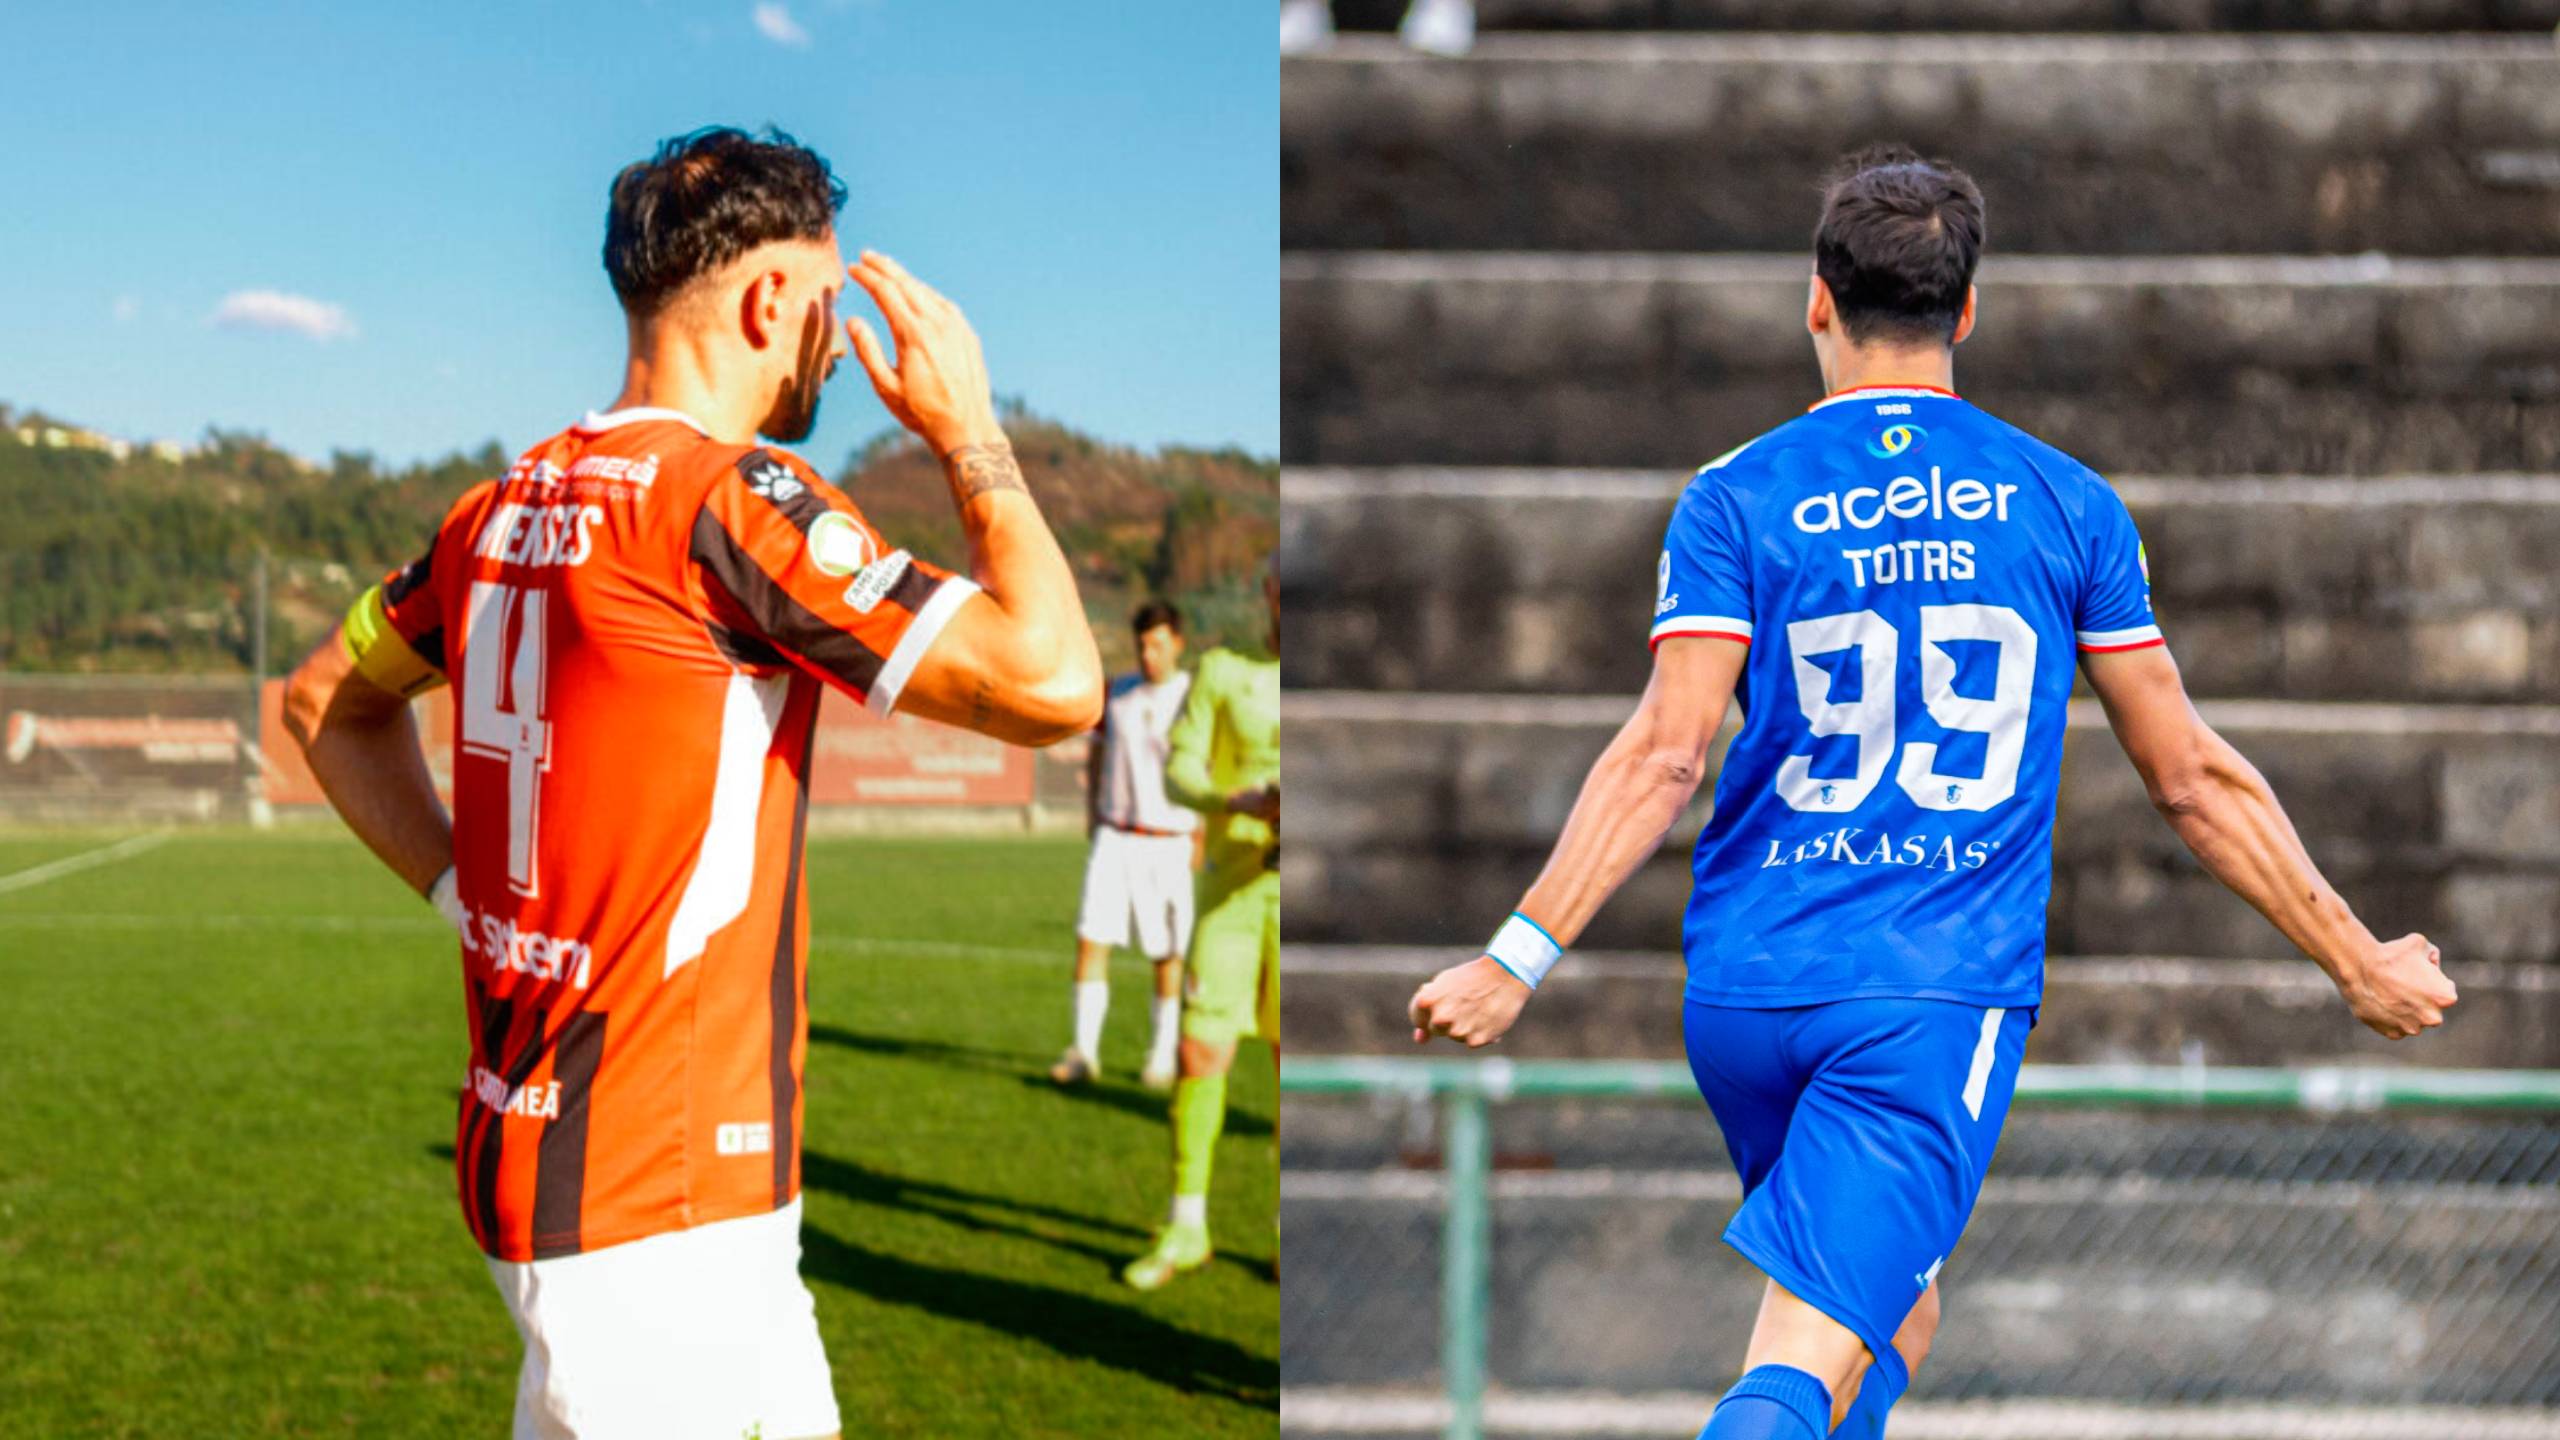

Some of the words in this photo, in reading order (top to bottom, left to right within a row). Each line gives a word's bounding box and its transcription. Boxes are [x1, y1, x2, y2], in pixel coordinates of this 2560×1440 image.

[1792, 465, 2019, 534] aceler
[1842, 540, 1976, 588] TOTAS
[462, 580, 552, 898] 4
[1776, 603, 2038, 812] 99
[1761, 827, 1989, 872] LASKASAS
